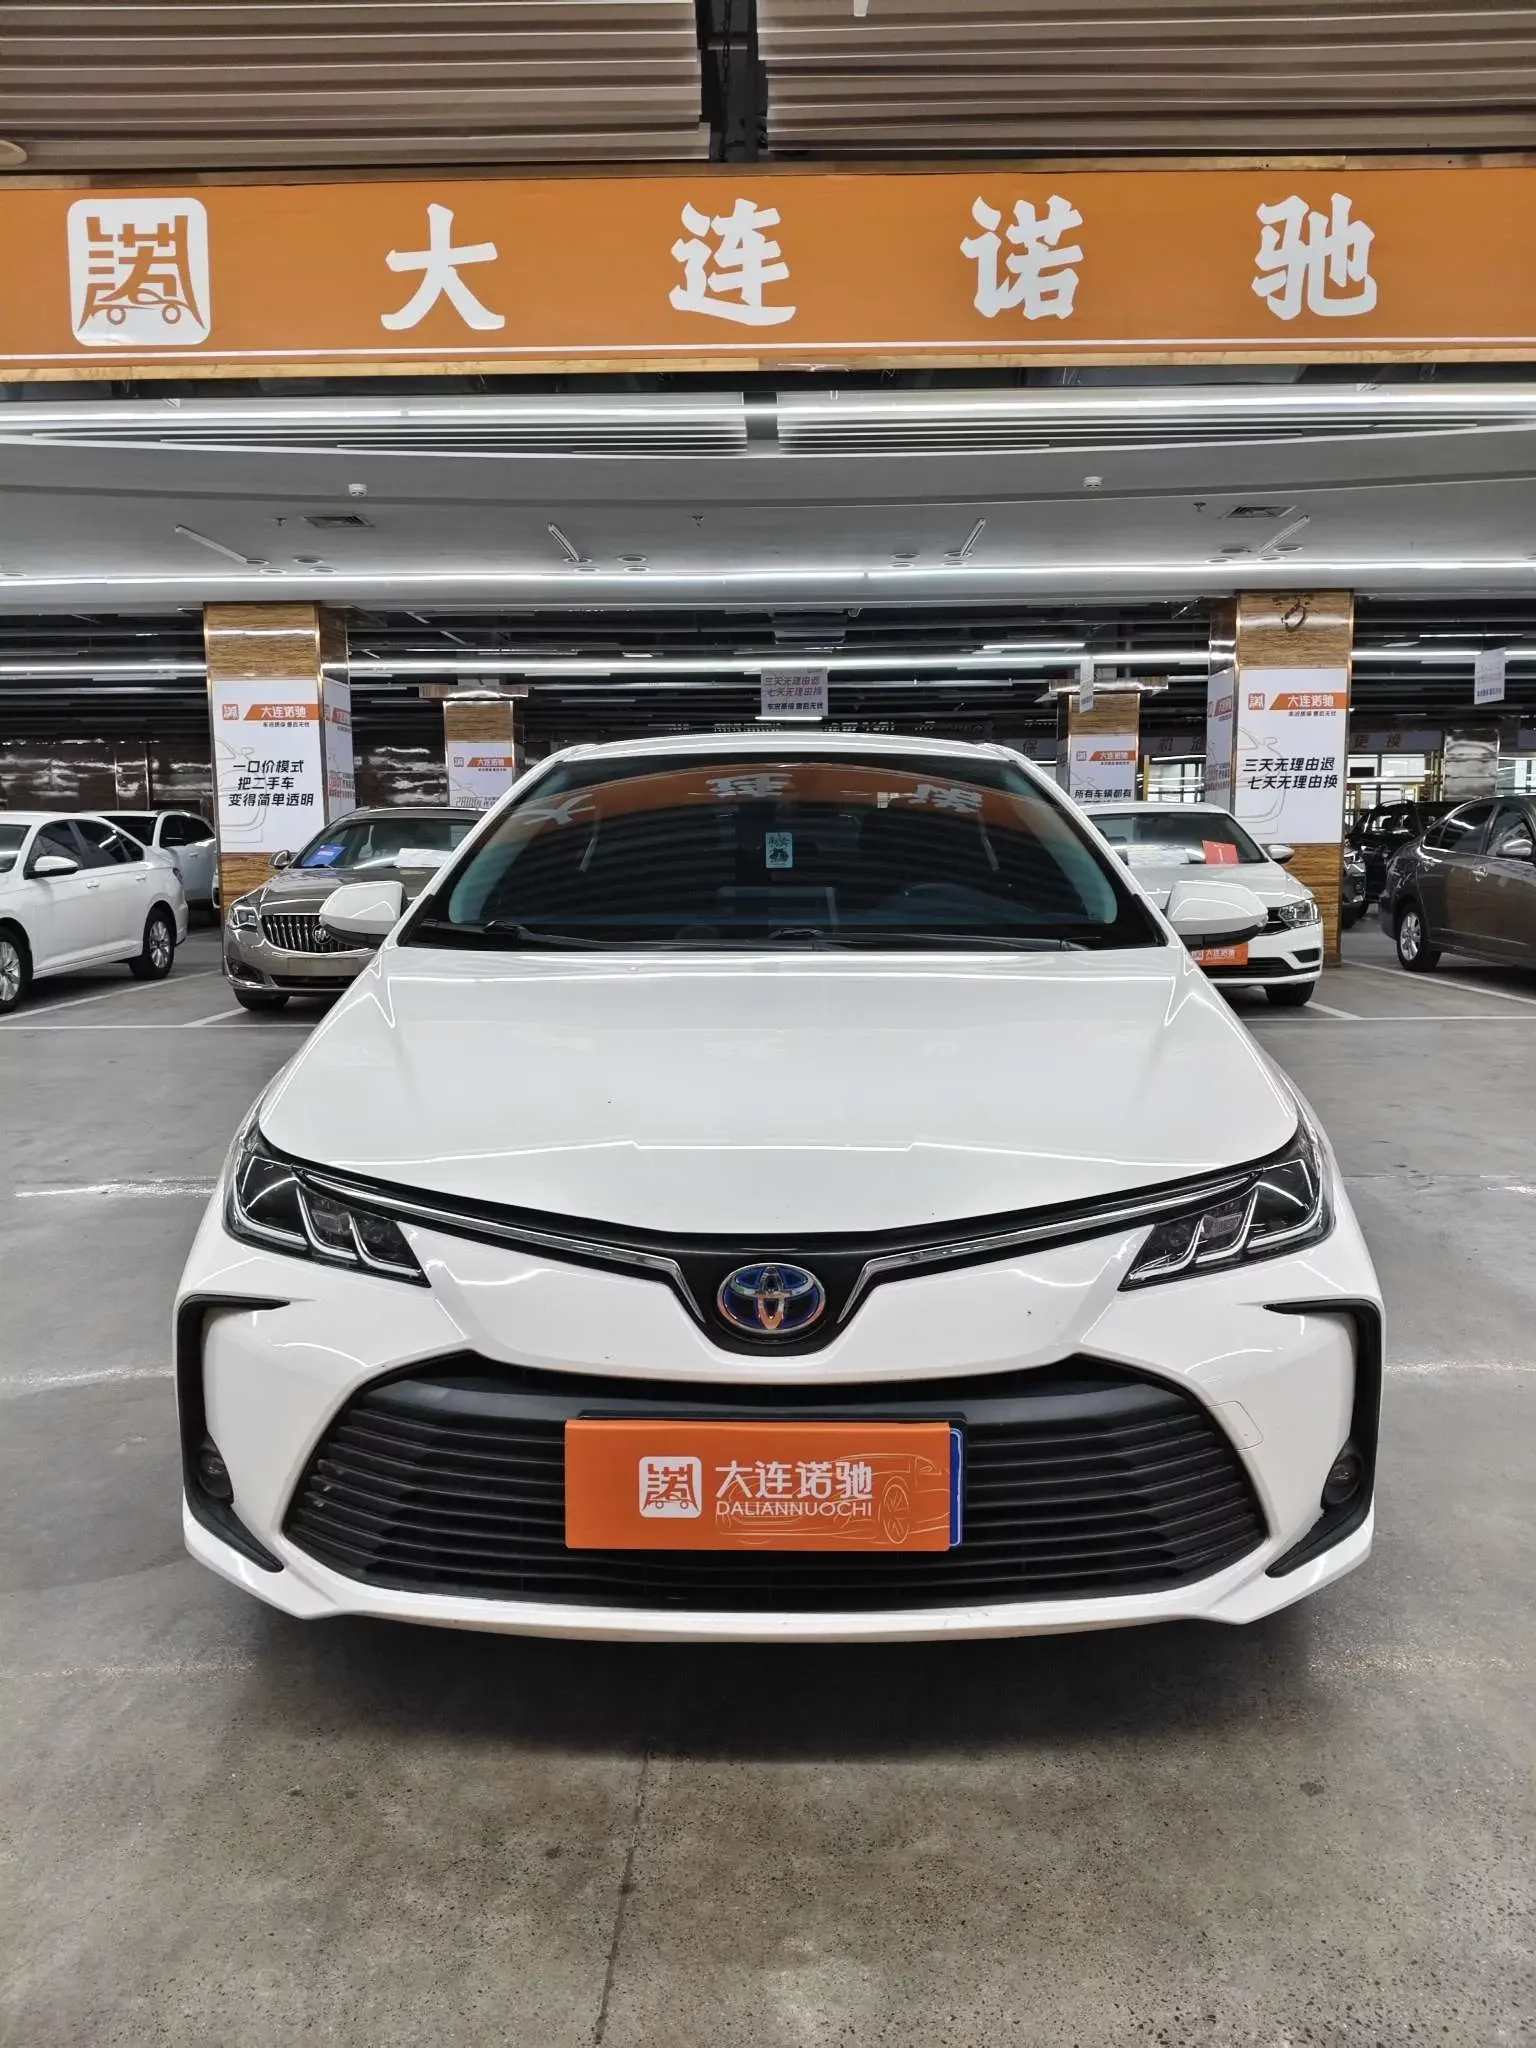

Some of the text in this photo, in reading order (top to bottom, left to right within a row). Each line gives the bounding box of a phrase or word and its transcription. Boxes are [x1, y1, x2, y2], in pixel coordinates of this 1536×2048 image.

[380, 194, 1379, 332] 大连诺驰
[1287, 694, 1334, 707] 大连诺驰
[259, 705, 307, 719] 大连诺驰
[233, 760, 304, 774] 一口价模式
[1243, 757, 1335, 772] 三天无理由退
[237, 777, 295, 791] 把二手车
[1248, 774, 1338, 790] 七天无理由换
[228, 793, 314, 807] 变得简单透明
[715, 1460, 873, 1499] 大连诺驰
[716, 1501, 873, 1517] DALIANNUOCHI
